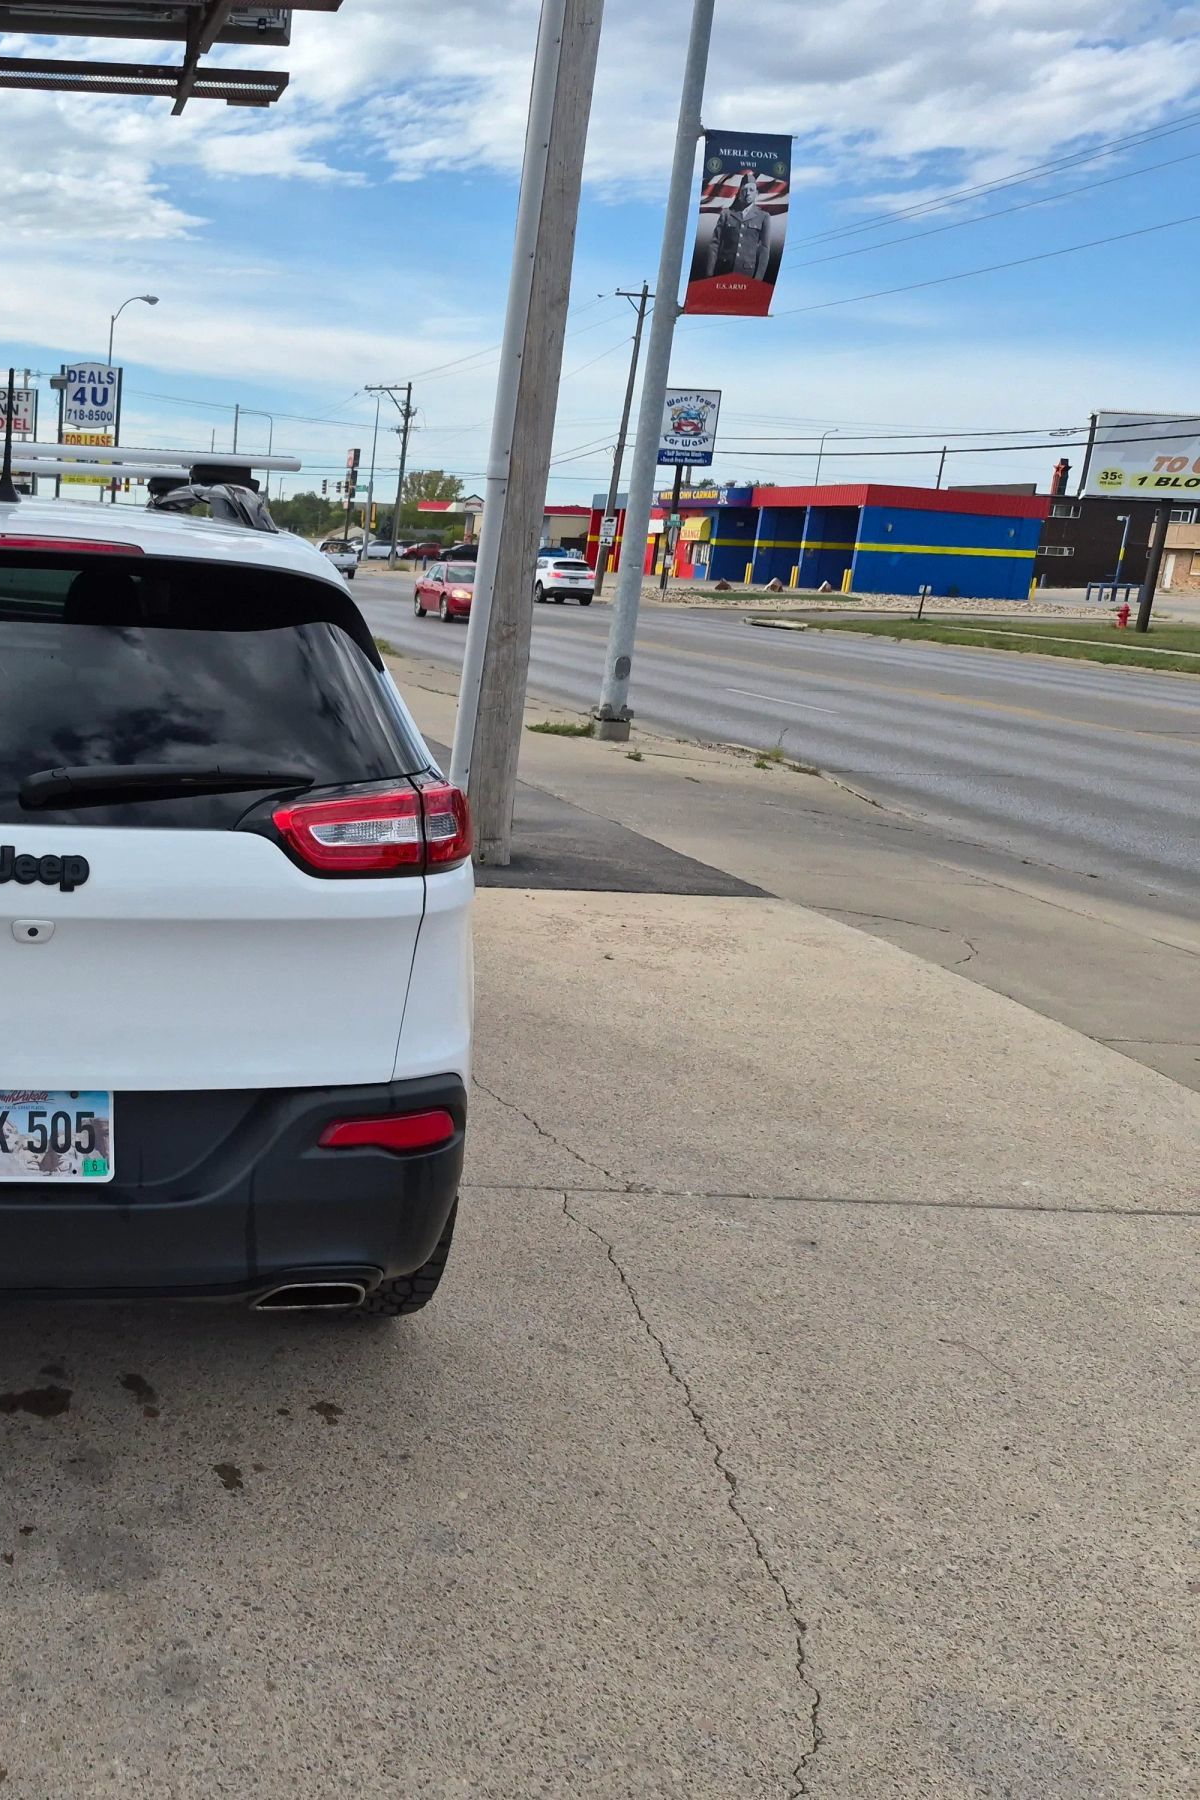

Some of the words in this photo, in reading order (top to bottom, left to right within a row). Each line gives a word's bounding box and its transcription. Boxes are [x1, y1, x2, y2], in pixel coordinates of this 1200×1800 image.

[719, 148, 749, 158] MERLE
[751, 151, 778, 159] COATS
[68, 370, 114, 385] DEALS
[667, 396, 692, 407] Water
[696, 395, 716, 410] Town
[67, 409, 113, 421] 718-8500
[65, 434, 82, 446] FOR
[85, 435, 112, 447] LEASE
[664, 435, 679, 446] Car
[681, 436, 709, 447] Wash
[1152, 455, 1189, 473] TO
[1137, 476, 1149, 486] 1
[693, 489, 718, 500] CARWASH
[27, 1111, 96, 1154] 505
